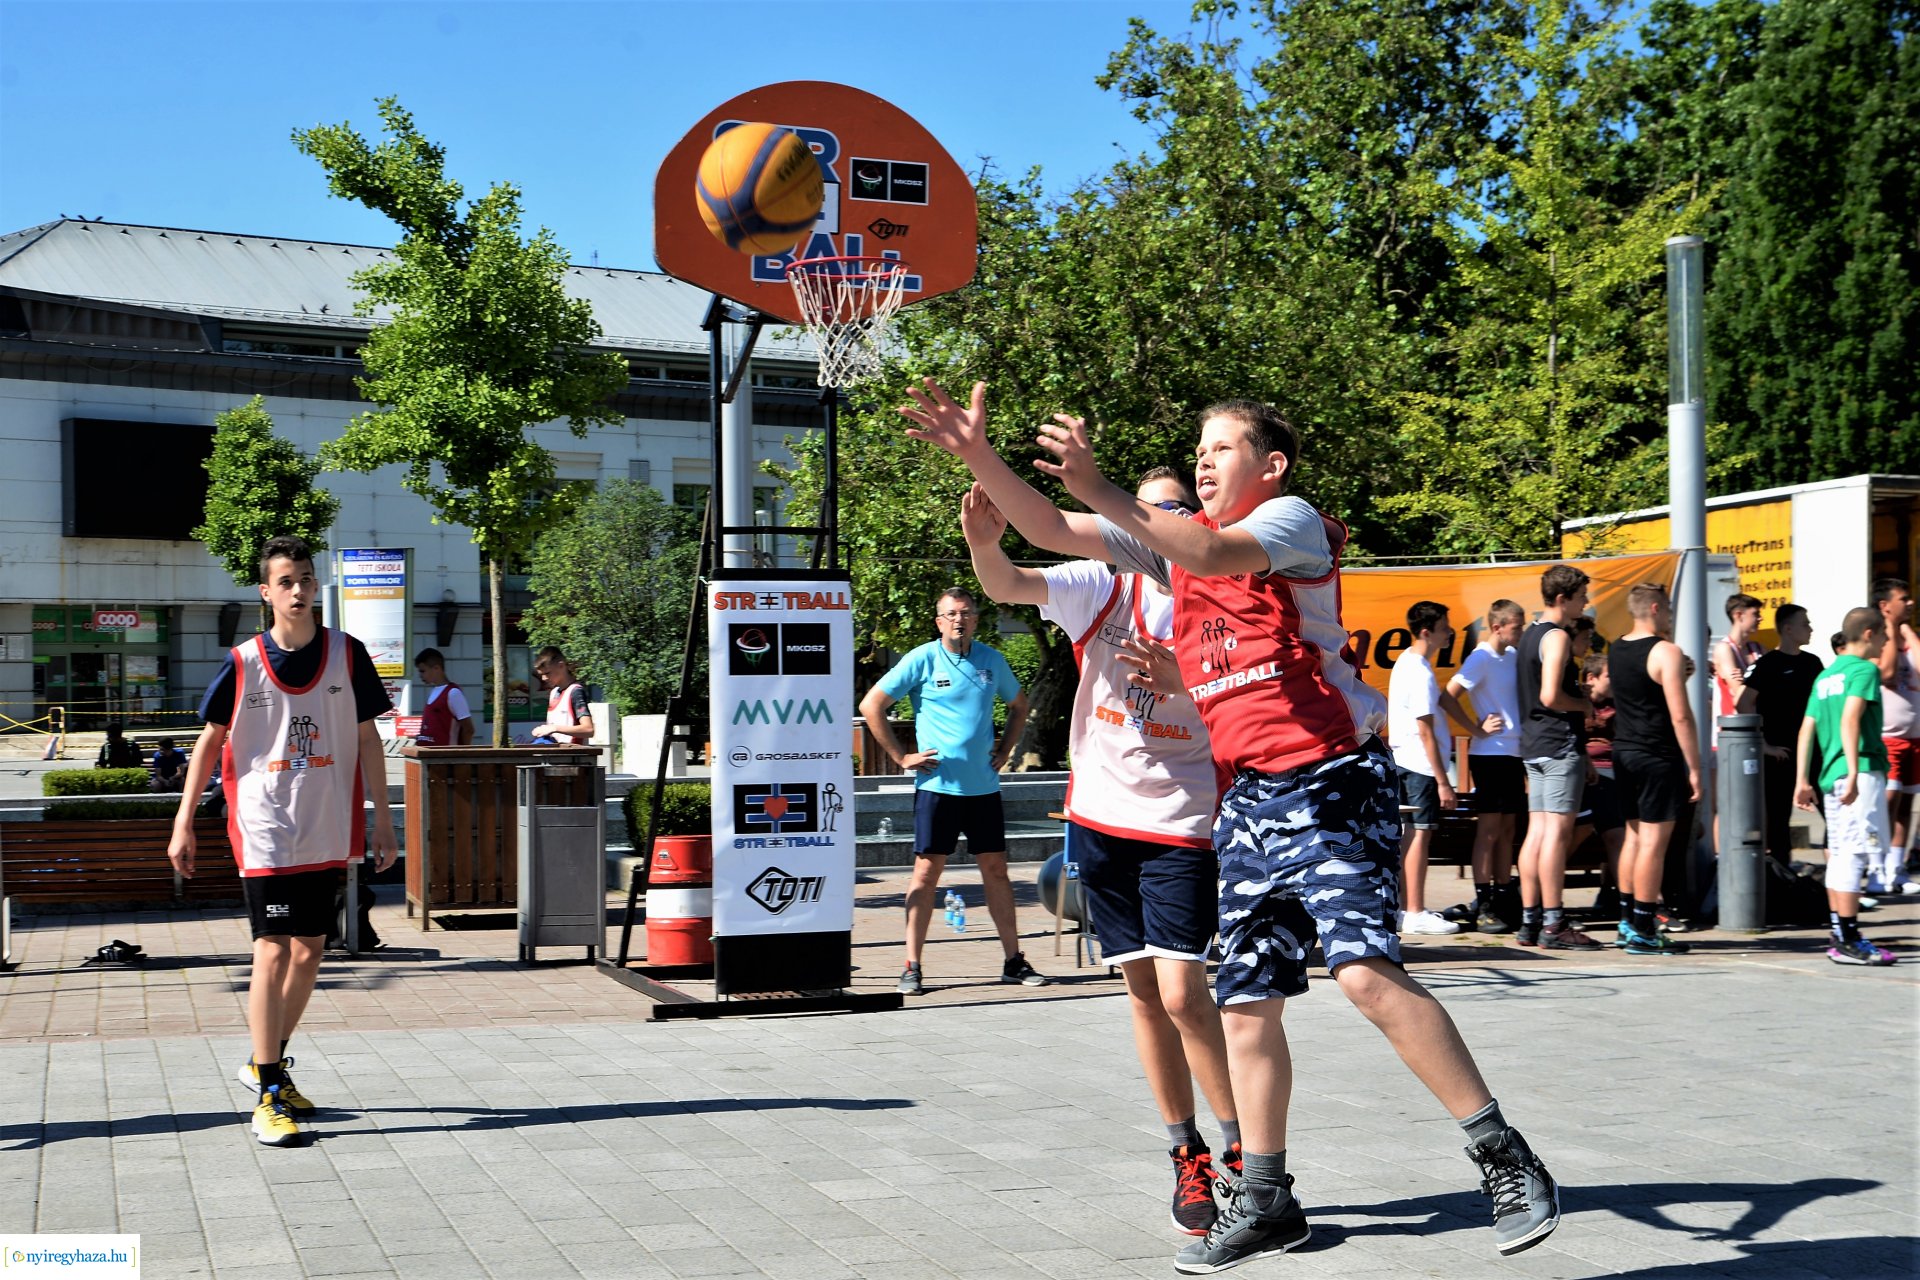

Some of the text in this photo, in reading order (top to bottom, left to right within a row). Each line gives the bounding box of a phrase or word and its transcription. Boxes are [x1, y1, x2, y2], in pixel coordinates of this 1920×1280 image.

[751, 233, 922, 292] BALL
[375, 563, 401, 572] ISKOLA
[1738, 561, 1792, 574] ntertran
[714, 592, 849, 610] STREETBALL
[98, 613, 136, 628] coop
[1188, 660, 1284, 702] TREETBALL
[732, 699, 833, 725] MVM
[1095, 705, 1192, 740] STREETBALL
[755, 752, 841, 761] GROSBASKET
[734, 836, 835, 849] STREETBALL
[764, 876, 826, 903] TOTI
